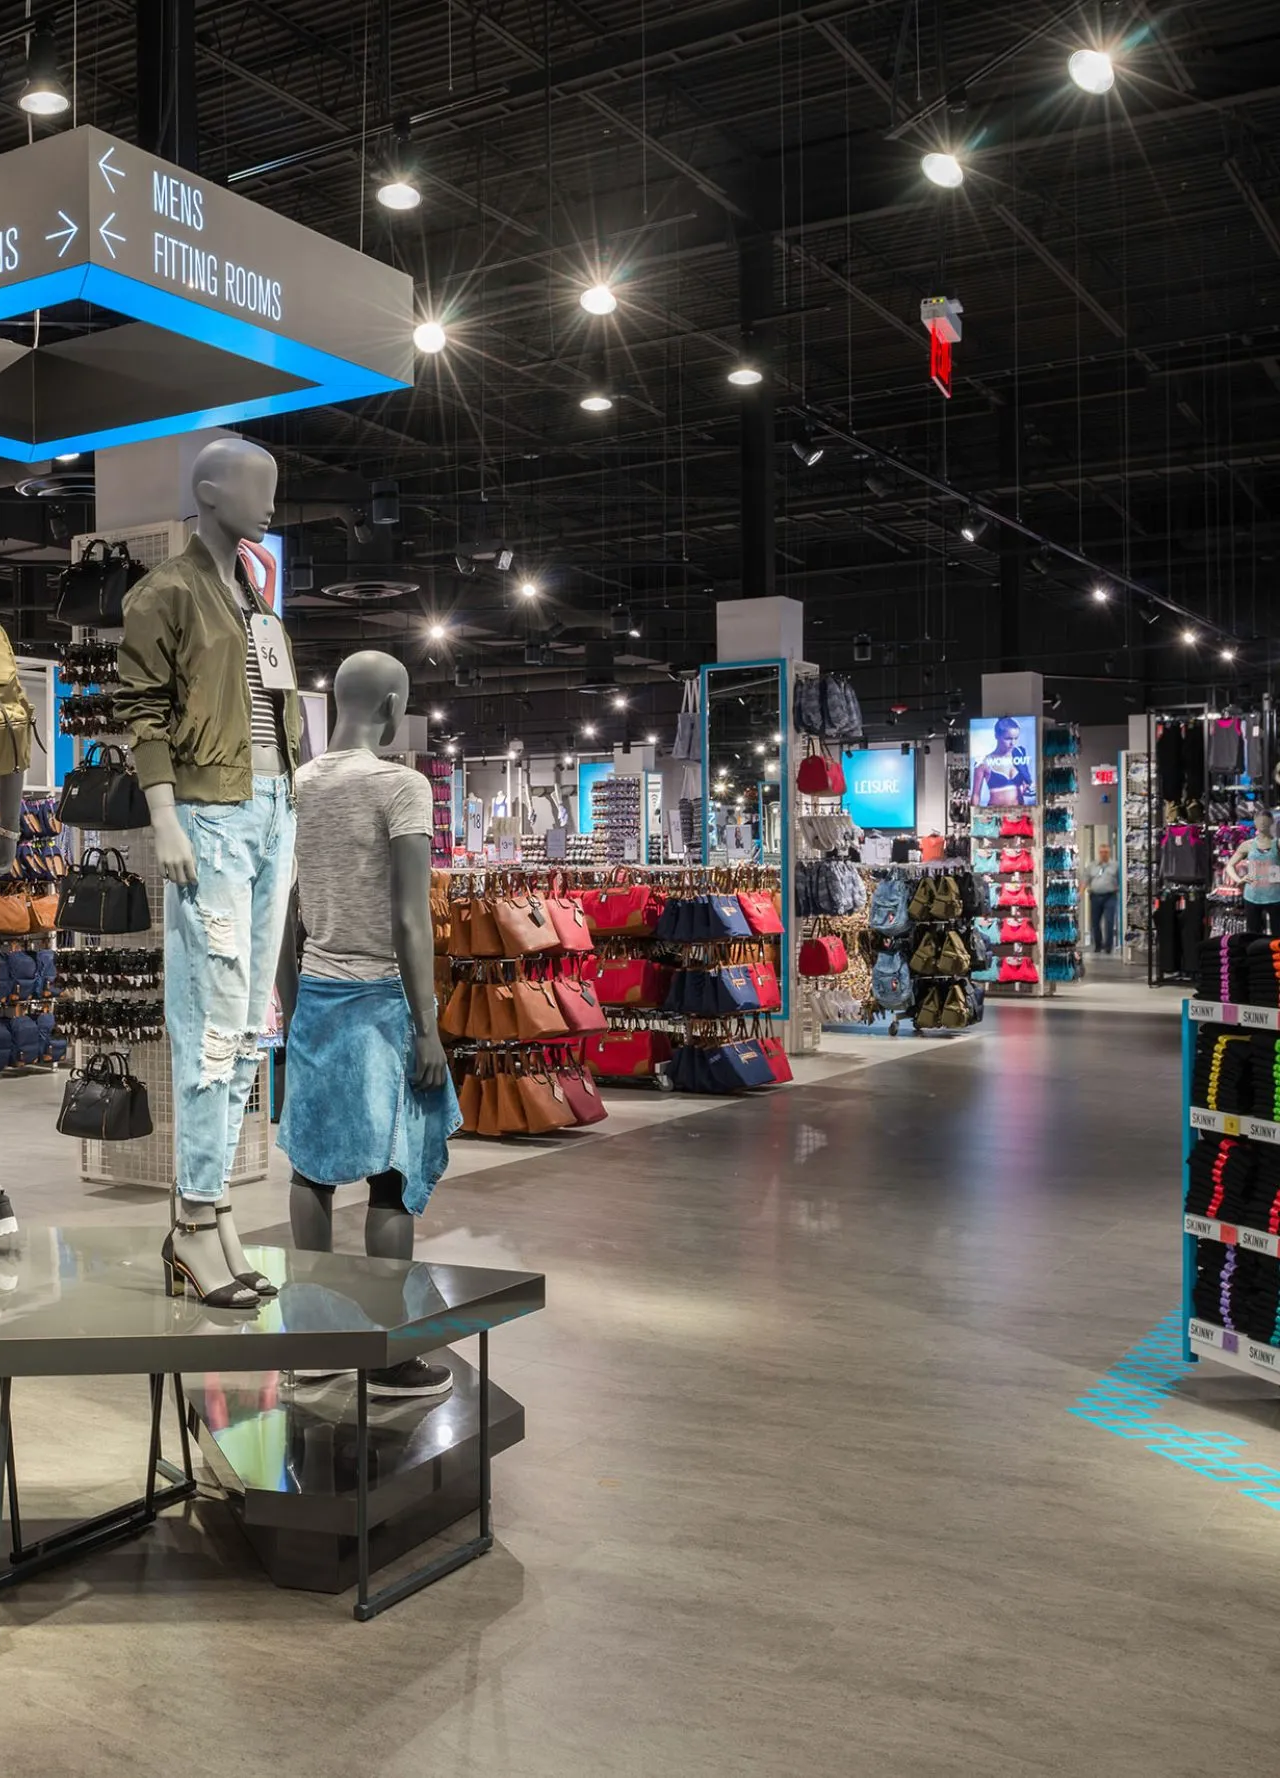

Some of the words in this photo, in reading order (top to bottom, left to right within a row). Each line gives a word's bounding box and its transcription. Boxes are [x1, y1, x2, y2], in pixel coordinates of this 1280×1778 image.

[153, 170, 204, 232] MENS
[153, 232, 218, 297] FITTING
[225, 261, 282, 322] ROOMS
[260, 646, 278, 668] $6
[854, 779, 900, 794] LEISURE
[1190, 1005, 1214, 1018] SKINNY
[1243, 1011, 1269, 1025] SKINNY
[1191, 1113, 1216, 1127] SKINNY
[1250, 1124, 1277, 1139] SKINNY
[1186, 1218, 1211, 1235] SKINNY
[1242, 1232, 1269, 1250] SKINNY
[1190, 1323, 1214, 1341] SKINNY
[1249, 1346, 1276, 1366] SKINNY
